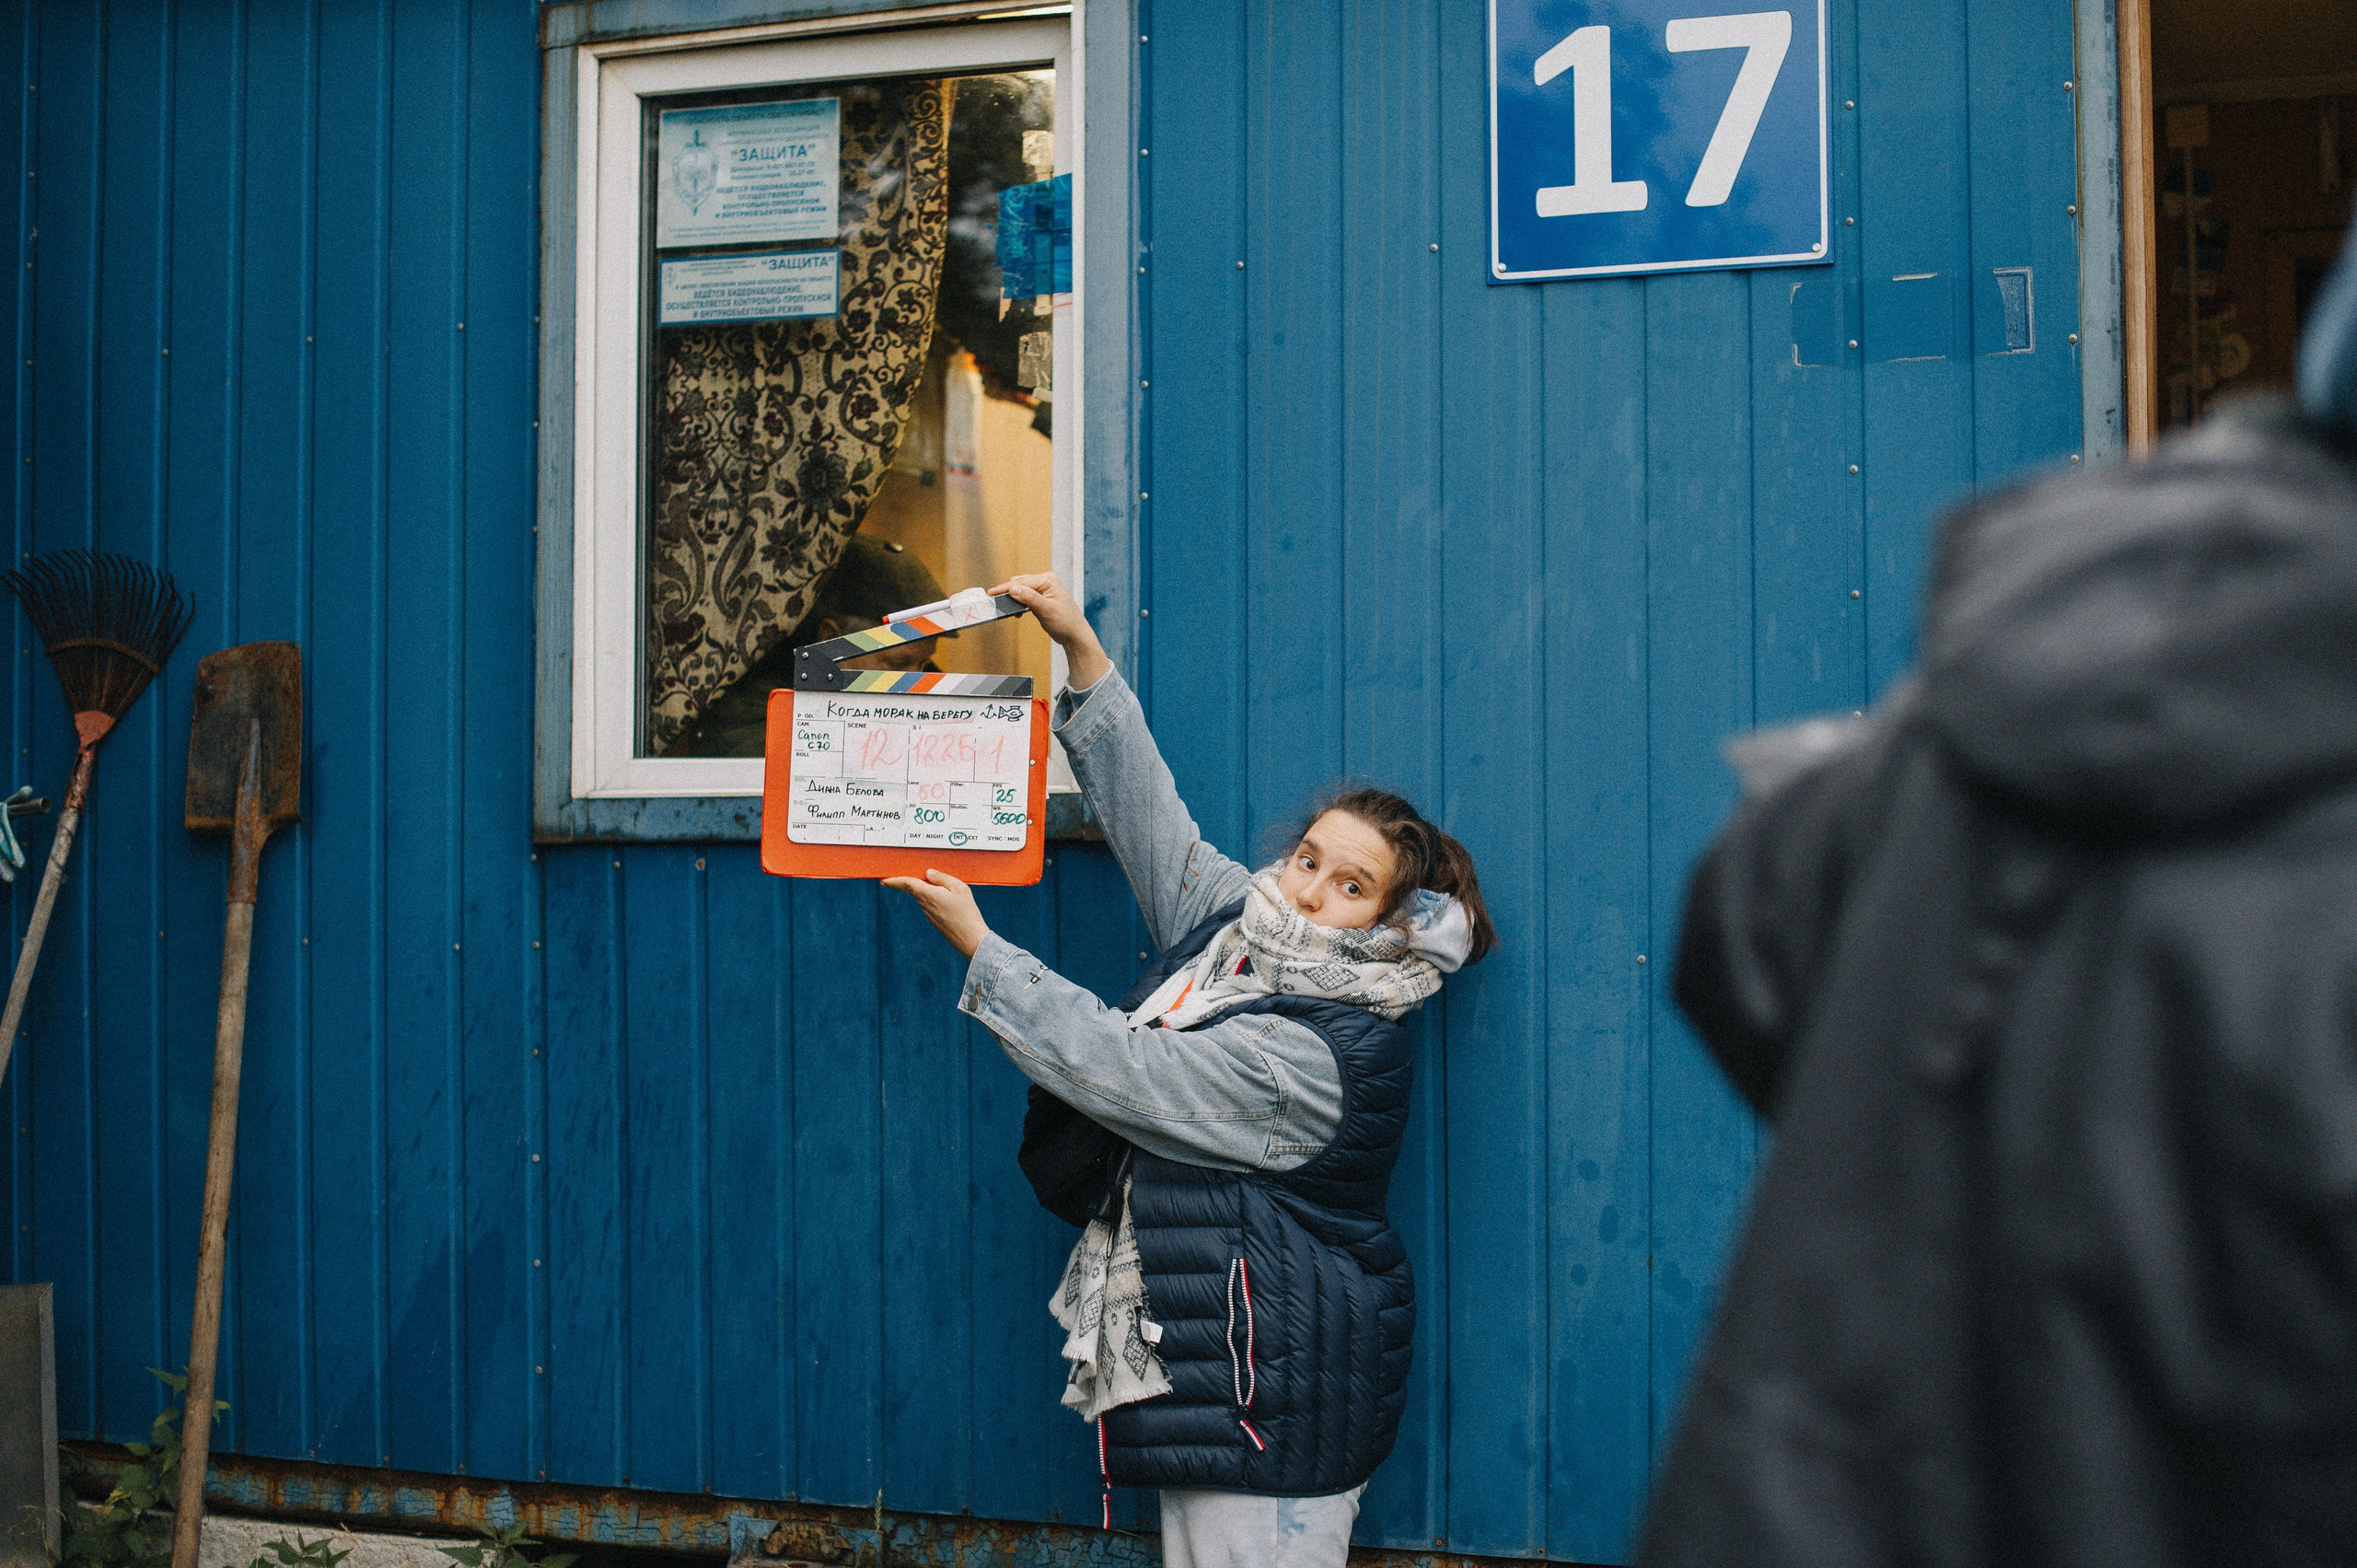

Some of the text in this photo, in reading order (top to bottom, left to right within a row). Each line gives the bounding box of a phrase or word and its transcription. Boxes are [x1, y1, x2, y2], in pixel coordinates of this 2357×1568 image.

[1534, 10, 1793, 218] 17
[917, 709, 930, 720] НА
[932, 709, 973, 720] БЕРЕГУ
[797, 729, 830, 742] Canon
[860, 727, 902, 772] 12
[990, 734, 1005, 774] 1
[995, 788, 1017, 804] 25
[913, 807, 946, 825] 800
[991, 811, 1027, 826] 5600
